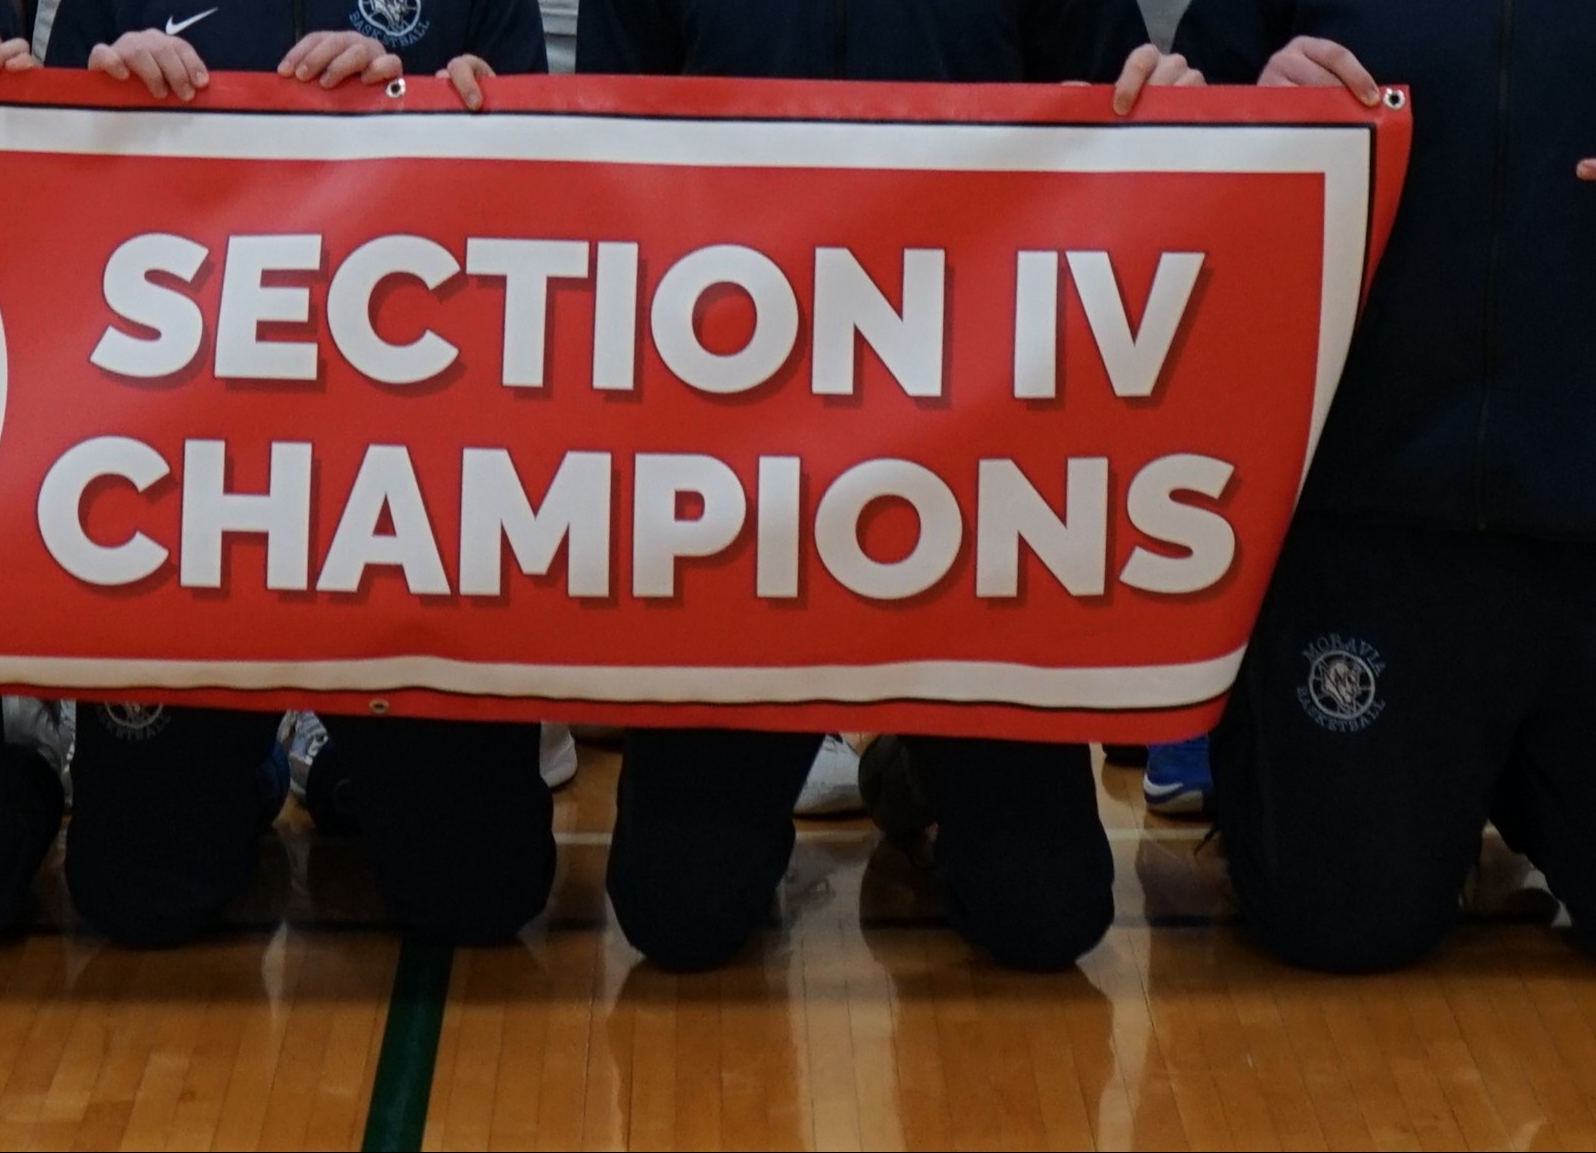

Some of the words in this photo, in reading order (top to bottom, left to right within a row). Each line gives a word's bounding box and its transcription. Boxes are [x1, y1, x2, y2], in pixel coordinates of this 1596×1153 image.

[89, 230, 947, 399] SECTION
[1013, 248, 1208, 401] IV
[37, 434, 1238, 601] CHAMPIONS
[1301, 632, 1386, 678] MORAVIA
